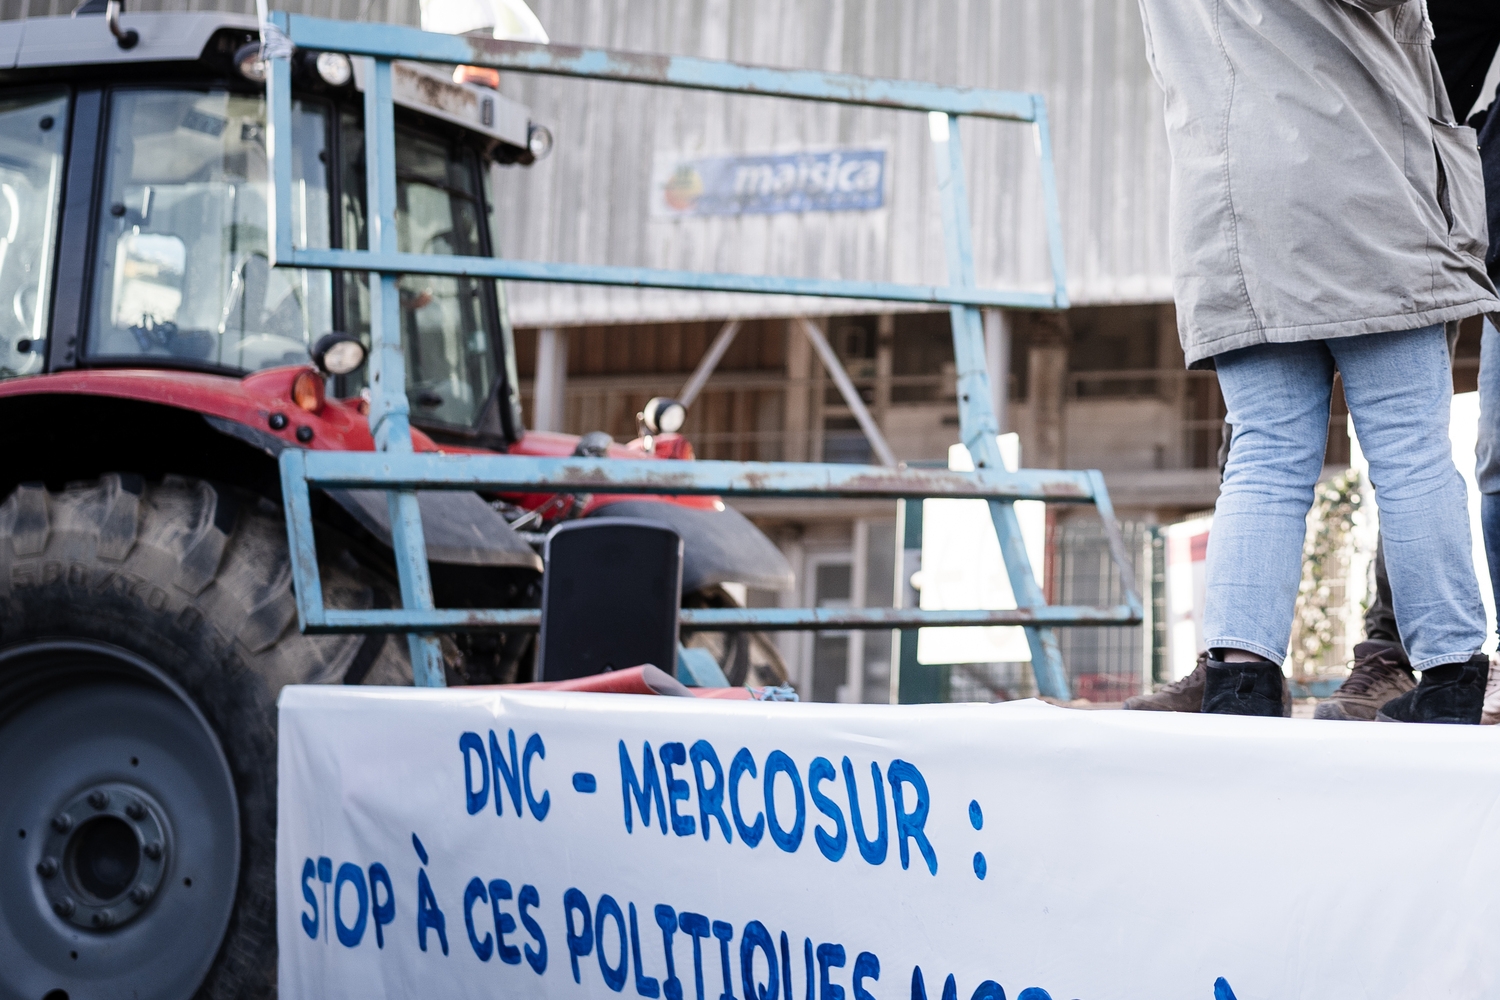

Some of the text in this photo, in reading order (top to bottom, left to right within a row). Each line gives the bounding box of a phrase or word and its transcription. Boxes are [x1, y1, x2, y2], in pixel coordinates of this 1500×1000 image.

[458, 727, 551, 822] DNC
[617, 738, 939, 877] MERCOSUR
[300, 832, 882, 1000] STOP À CES POLITIQUES
